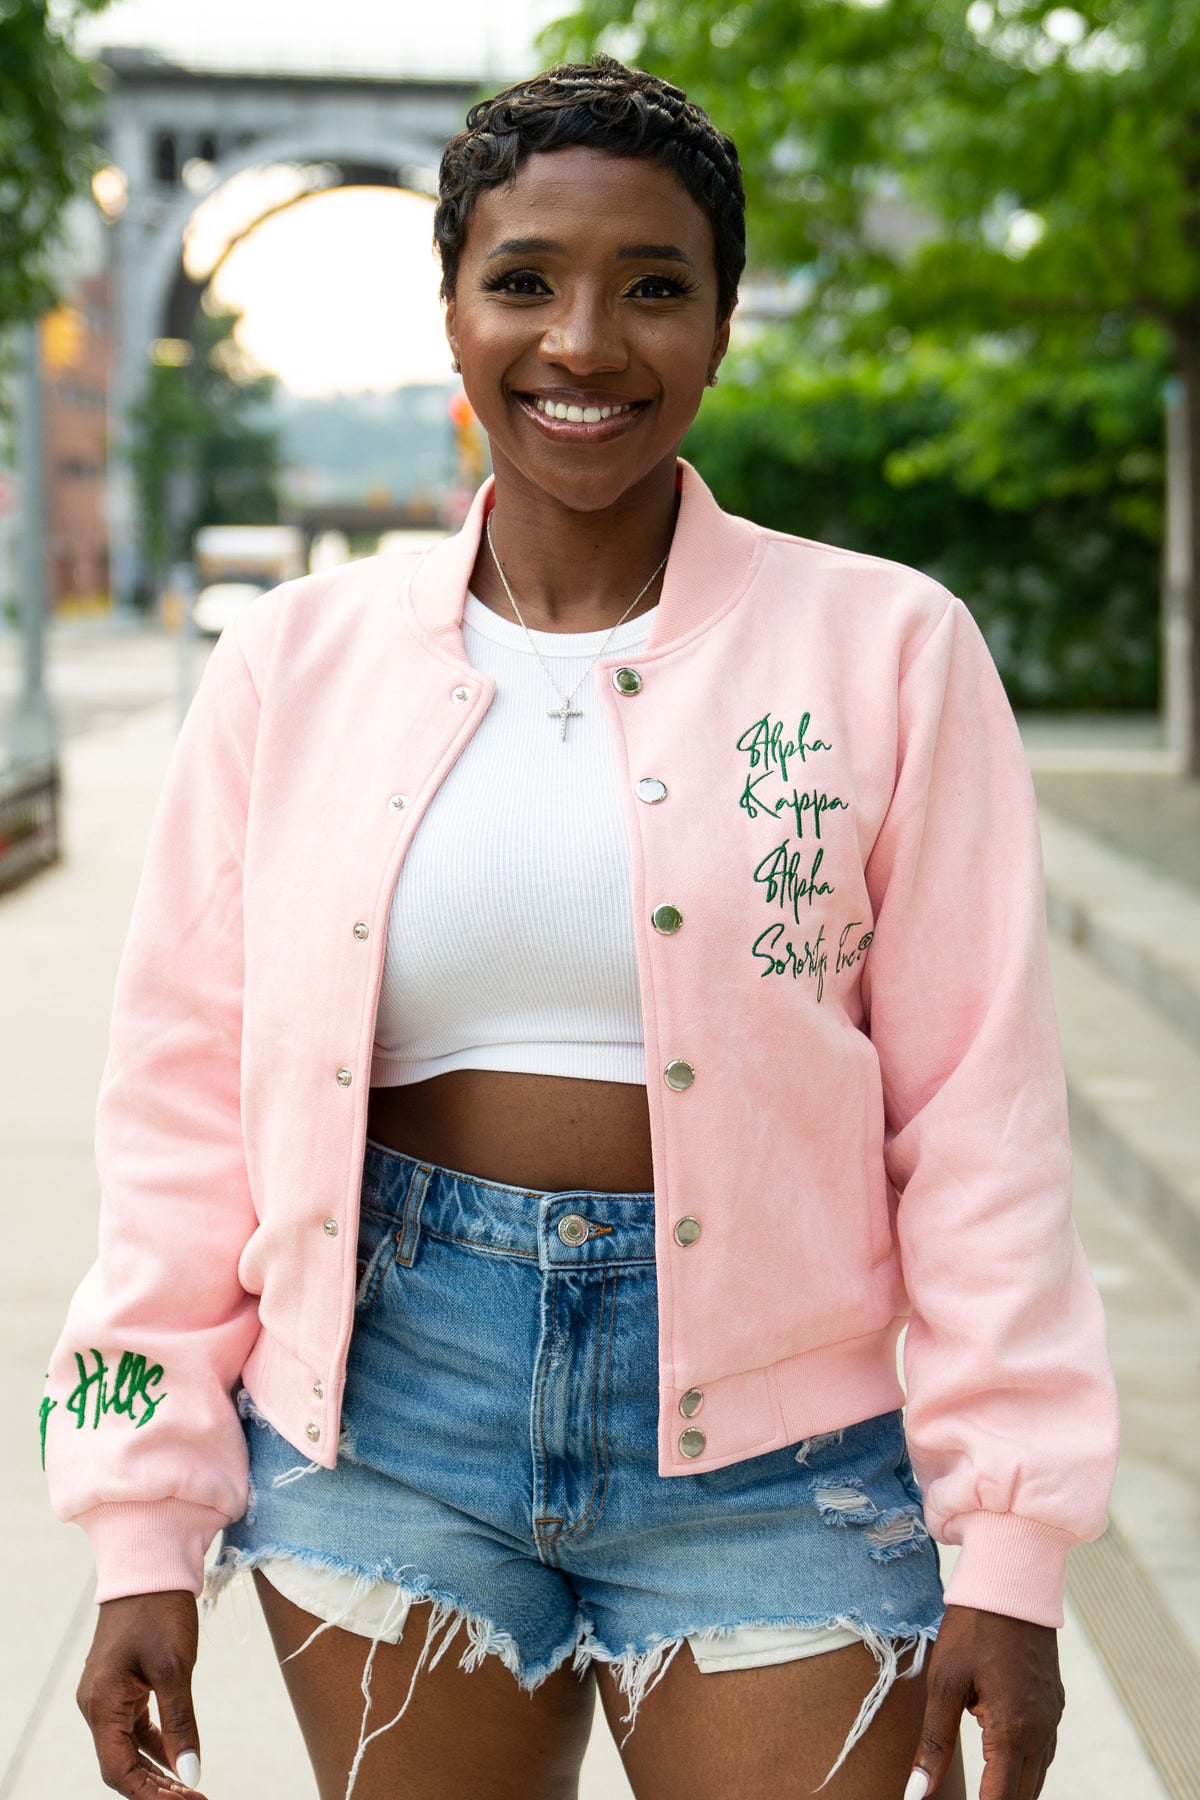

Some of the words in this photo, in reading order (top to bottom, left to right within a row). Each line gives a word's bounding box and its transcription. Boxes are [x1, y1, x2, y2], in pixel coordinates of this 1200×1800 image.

[736, 711, 833, 782] Alpha
[739, 770, 849, 839] Kappa
[753, 838, 835, 925] Alpha
[66, 1348, 168, 1430] Hills
